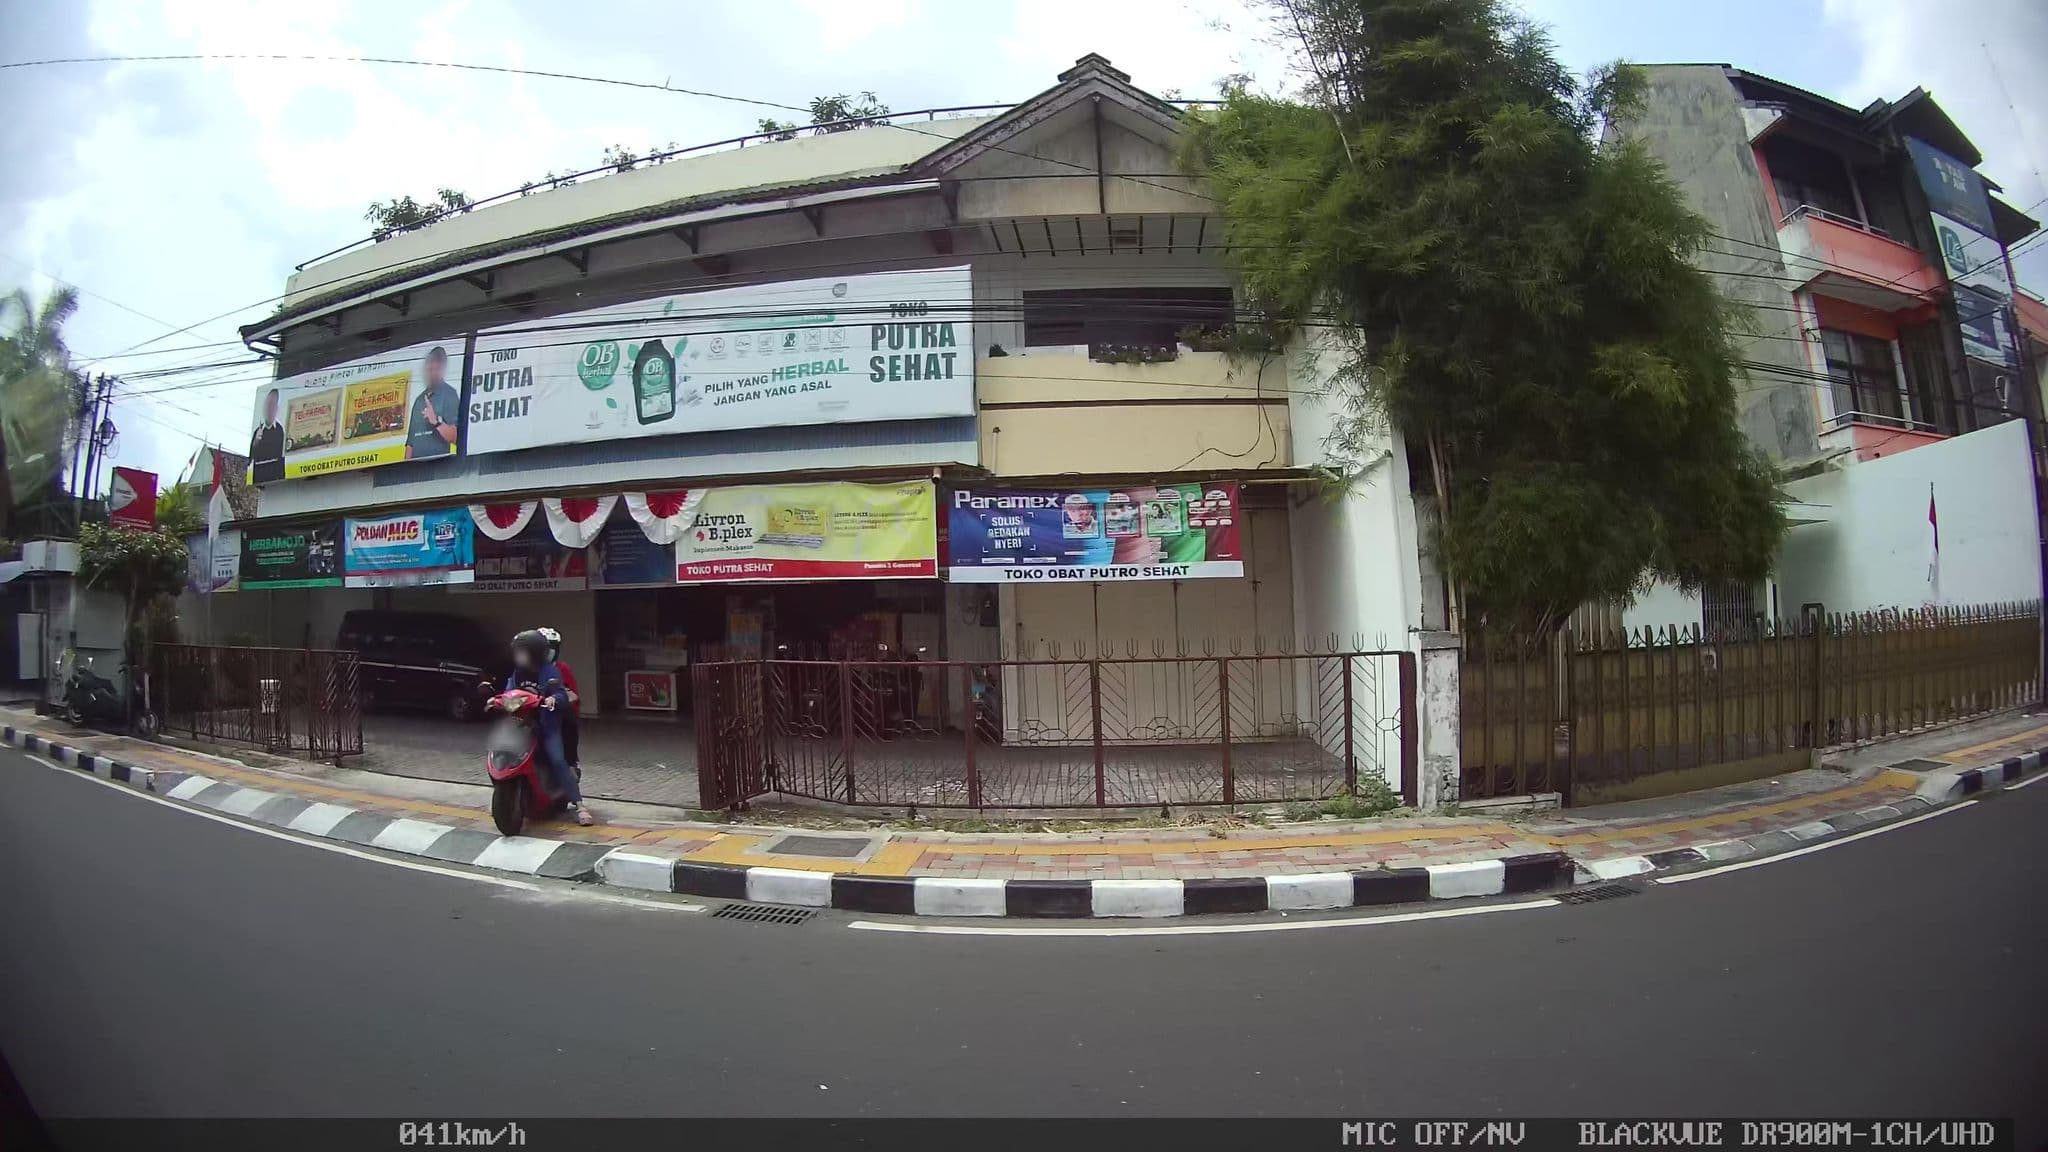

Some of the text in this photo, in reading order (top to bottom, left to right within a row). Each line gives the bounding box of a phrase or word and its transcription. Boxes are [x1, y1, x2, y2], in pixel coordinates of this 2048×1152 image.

[871, 322, 956, 351] PUTRA
[490, 348, 518, 364] TOKO
[583, 343, 615, 367] OB
[705, 381, 734, 394] PILIH
[737, 375, 769, 388] YANG
[771, 358, 850, 383] HERBAL
[869, 352, 957, 383] SEHAT
[471, 366, 534, 395] PUTRA
[713, 379, 832, 406] JANGAN YANG ASAL
[469, 395, 532, 424] SEHAT
[299, 453, 379, 474] TOKO OBAT PUTRO SEHAT
[954, 490, 1059, 509] Paramex
[691, 512, 746, 528] Livron
[991, 516, 1024, 527] SOLUSI
[708, 526, 752, 543] B.plex
[994, 538, 1022, 549] NYERI
[686, 563, 774, 575] TOKO PUTRA SEHAT
[1004, 565, 1190, 580] TOKO OBAT PUTRO SEHAT
